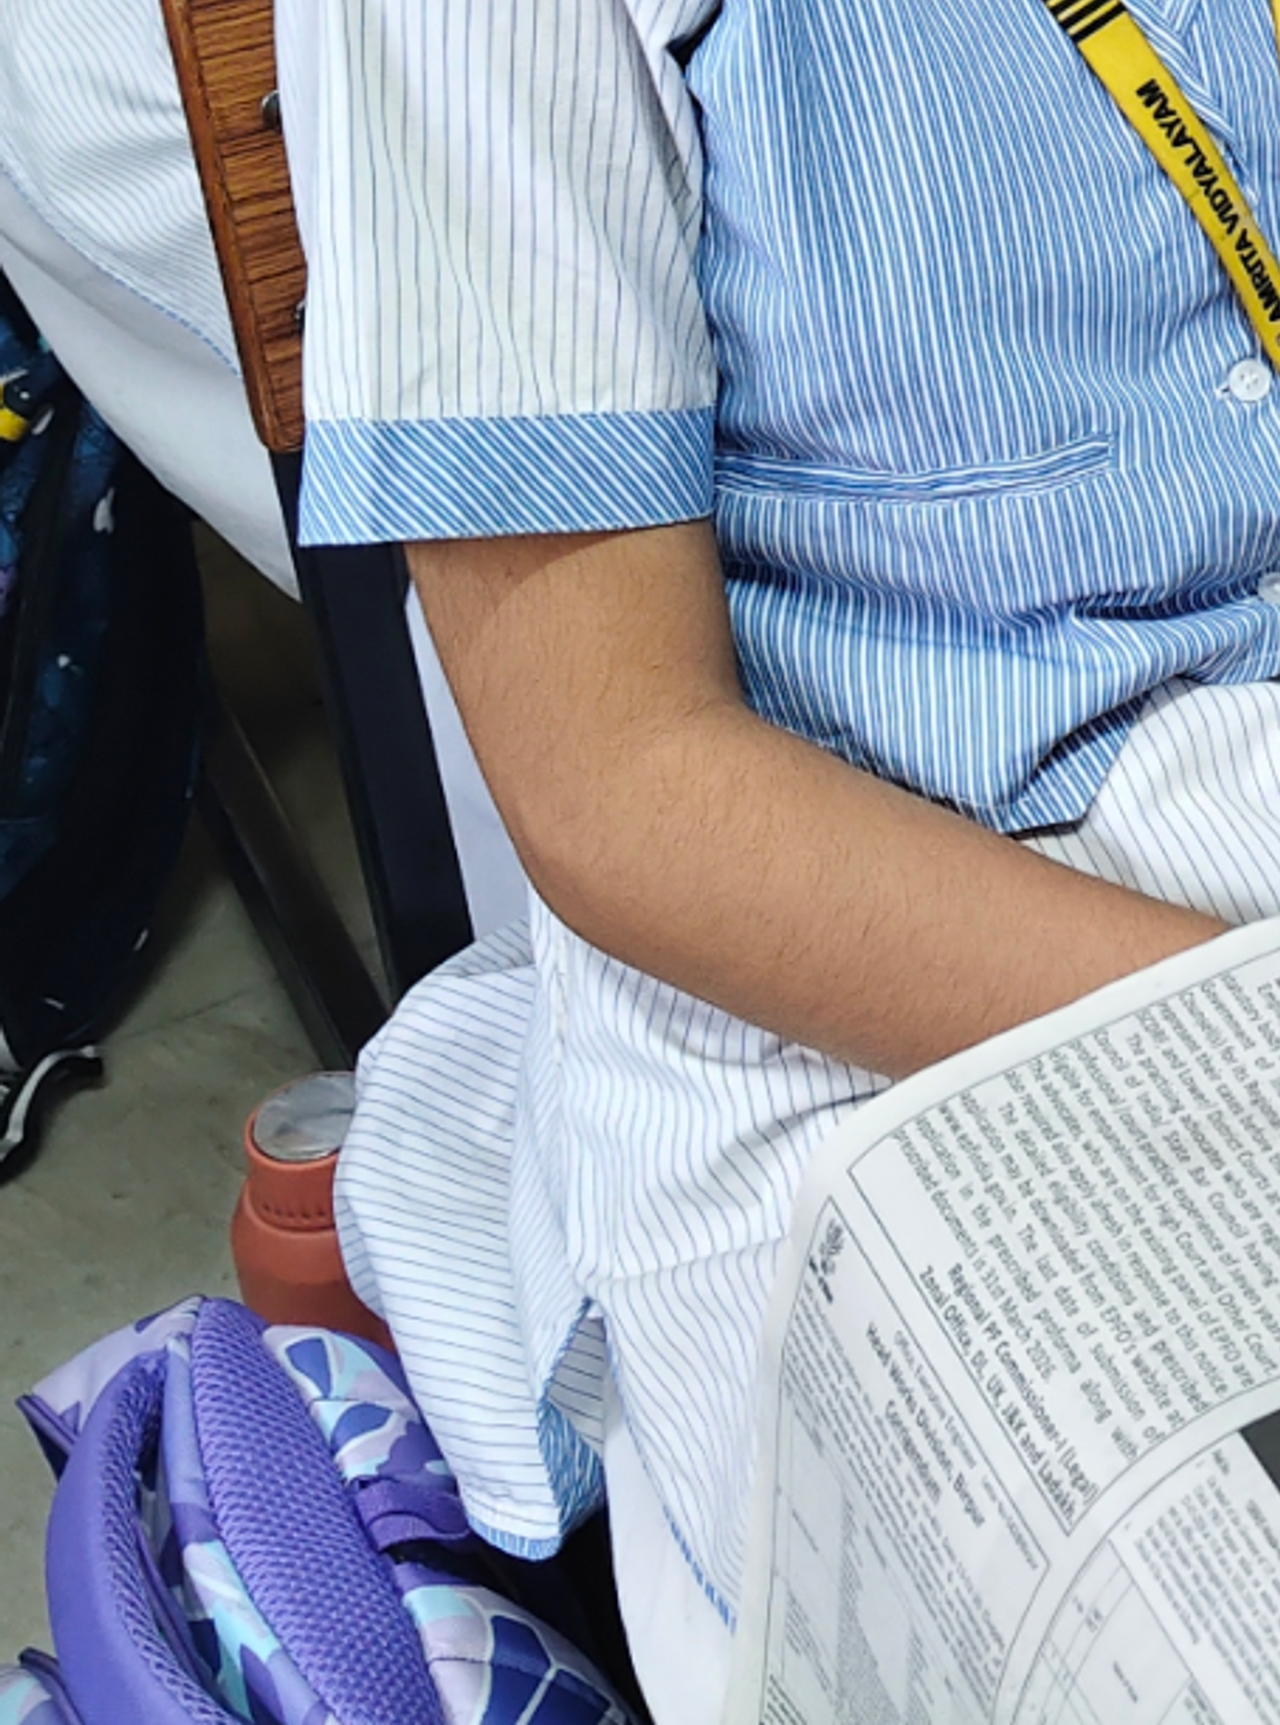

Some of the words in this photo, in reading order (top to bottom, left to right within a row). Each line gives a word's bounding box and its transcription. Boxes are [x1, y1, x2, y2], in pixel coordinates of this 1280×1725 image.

[1134, 77, 1242, 237] VIDYALAYAM
[941, 1259, 995, 1330] Regional
[979, 1323, 1005, 1348] PF
[1056, 1445, 1105, 1508] (Legal)
